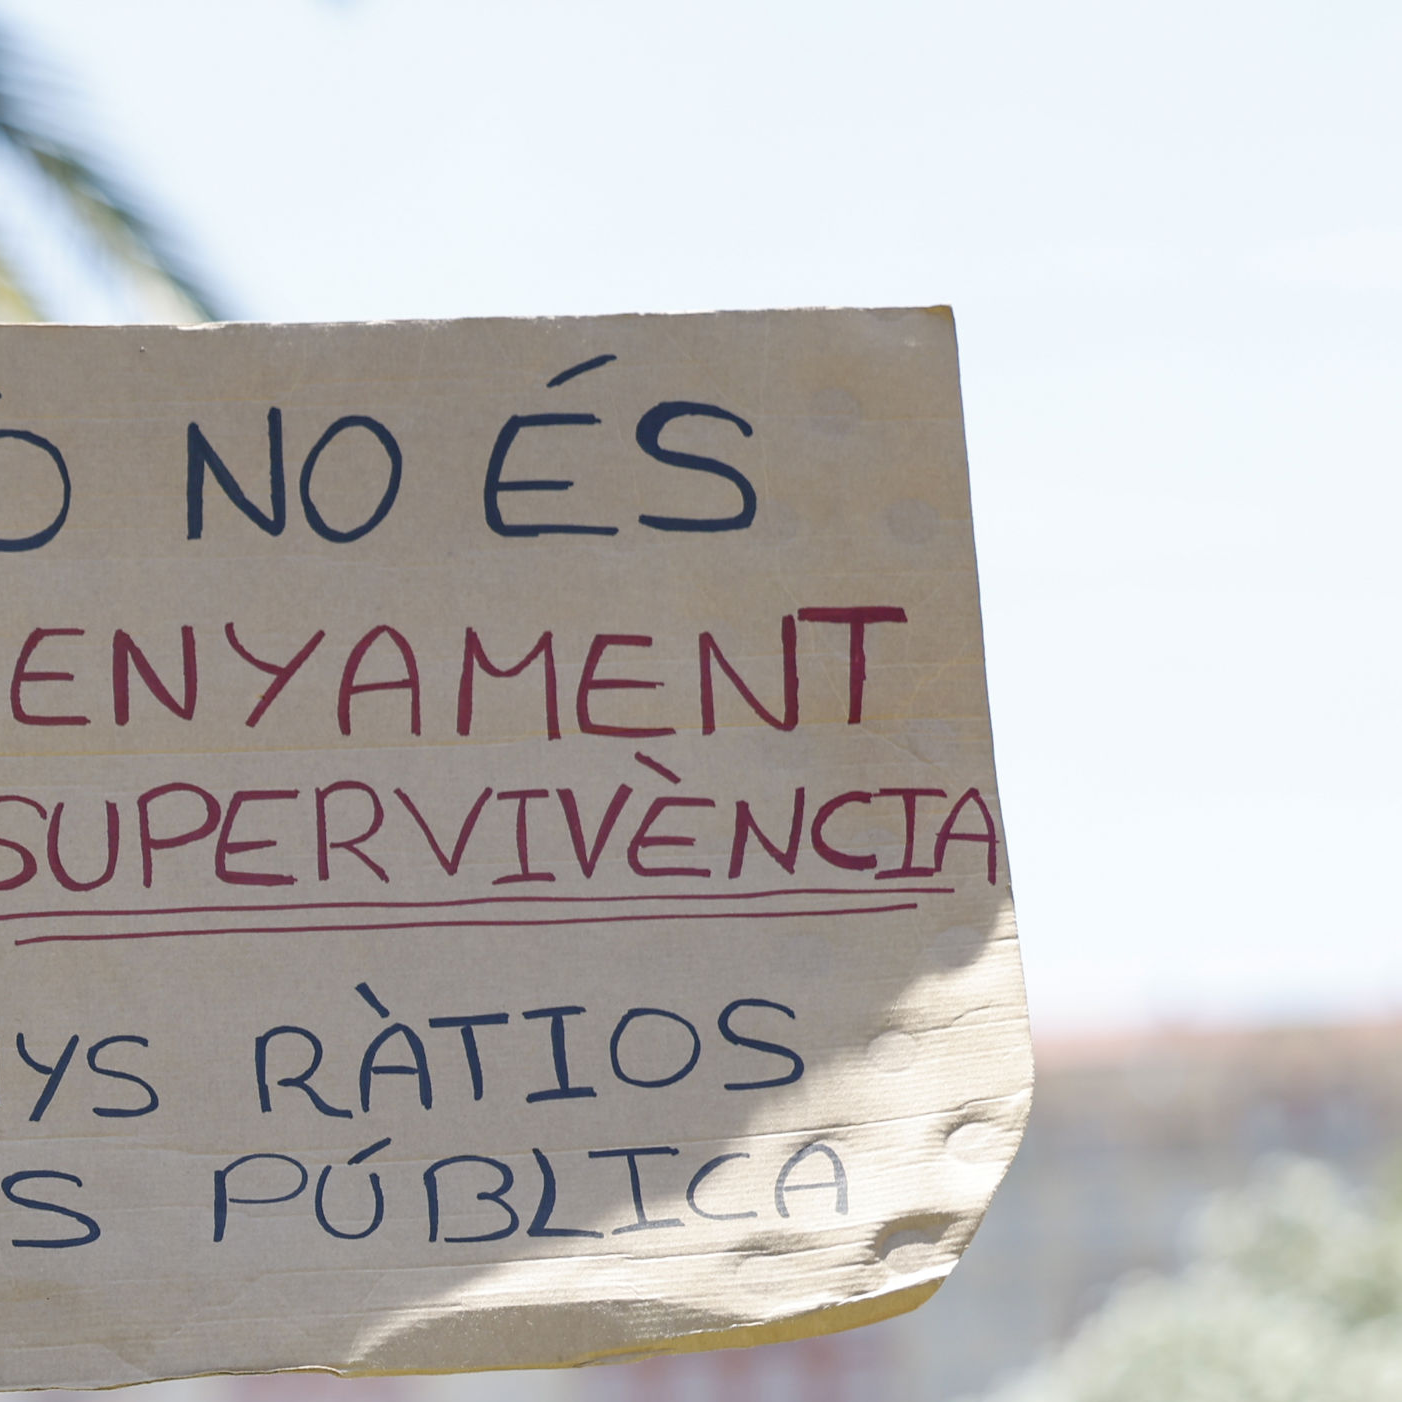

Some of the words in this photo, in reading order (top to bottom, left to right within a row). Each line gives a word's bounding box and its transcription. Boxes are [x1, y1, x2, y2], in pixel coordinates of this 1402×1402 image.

[186, 406, 403, 544] NO
[483, 354, 757, 538] ÉS
[254, 981, 805, 1120] RÀTIOS
[212, 1137, 849, 1245] PÚBLICA
